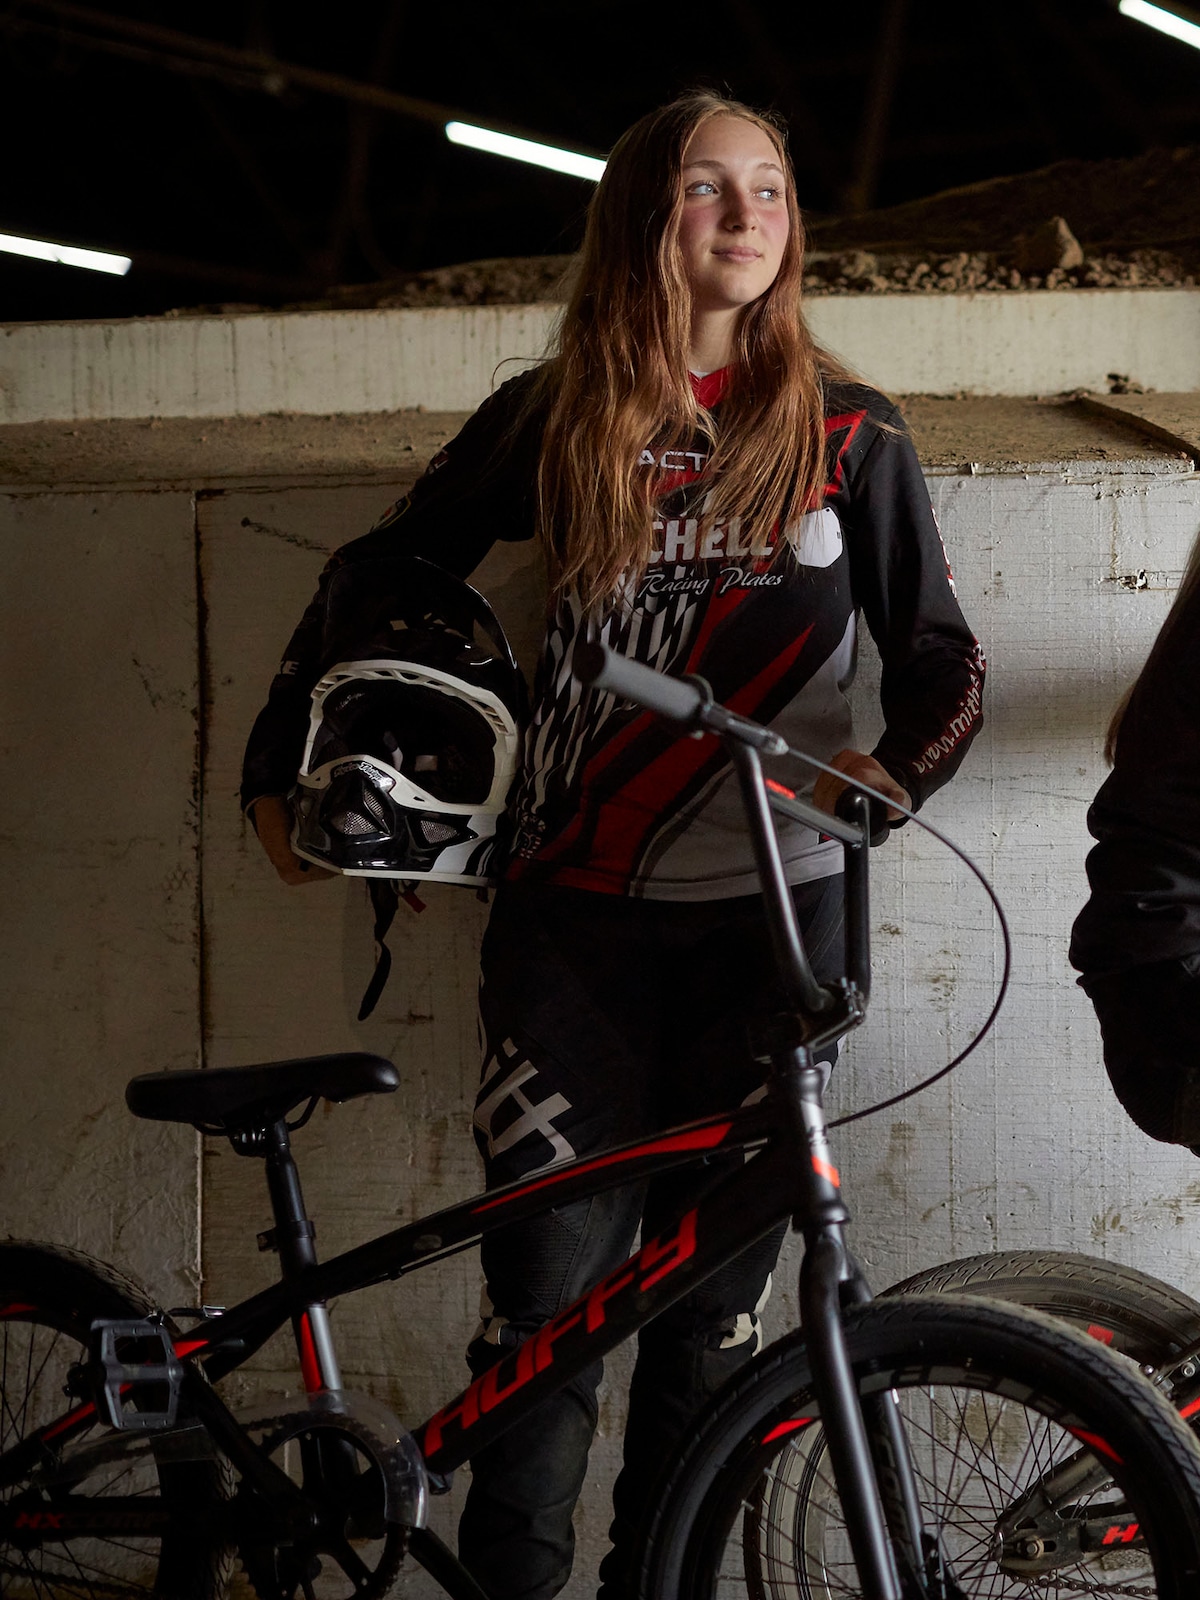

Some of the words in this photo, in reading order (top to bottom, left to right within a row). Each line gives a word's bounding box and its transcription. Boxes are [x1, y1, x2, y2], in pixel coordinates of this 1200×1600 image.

[637, 449, 707, 472] ACT
[648, 516, 774, 564] CHELL
[638, 573, 711, 599] Racing
[719, 566, 784, 594] Plates
[424, 1207, 698, 1458] HUFFY
